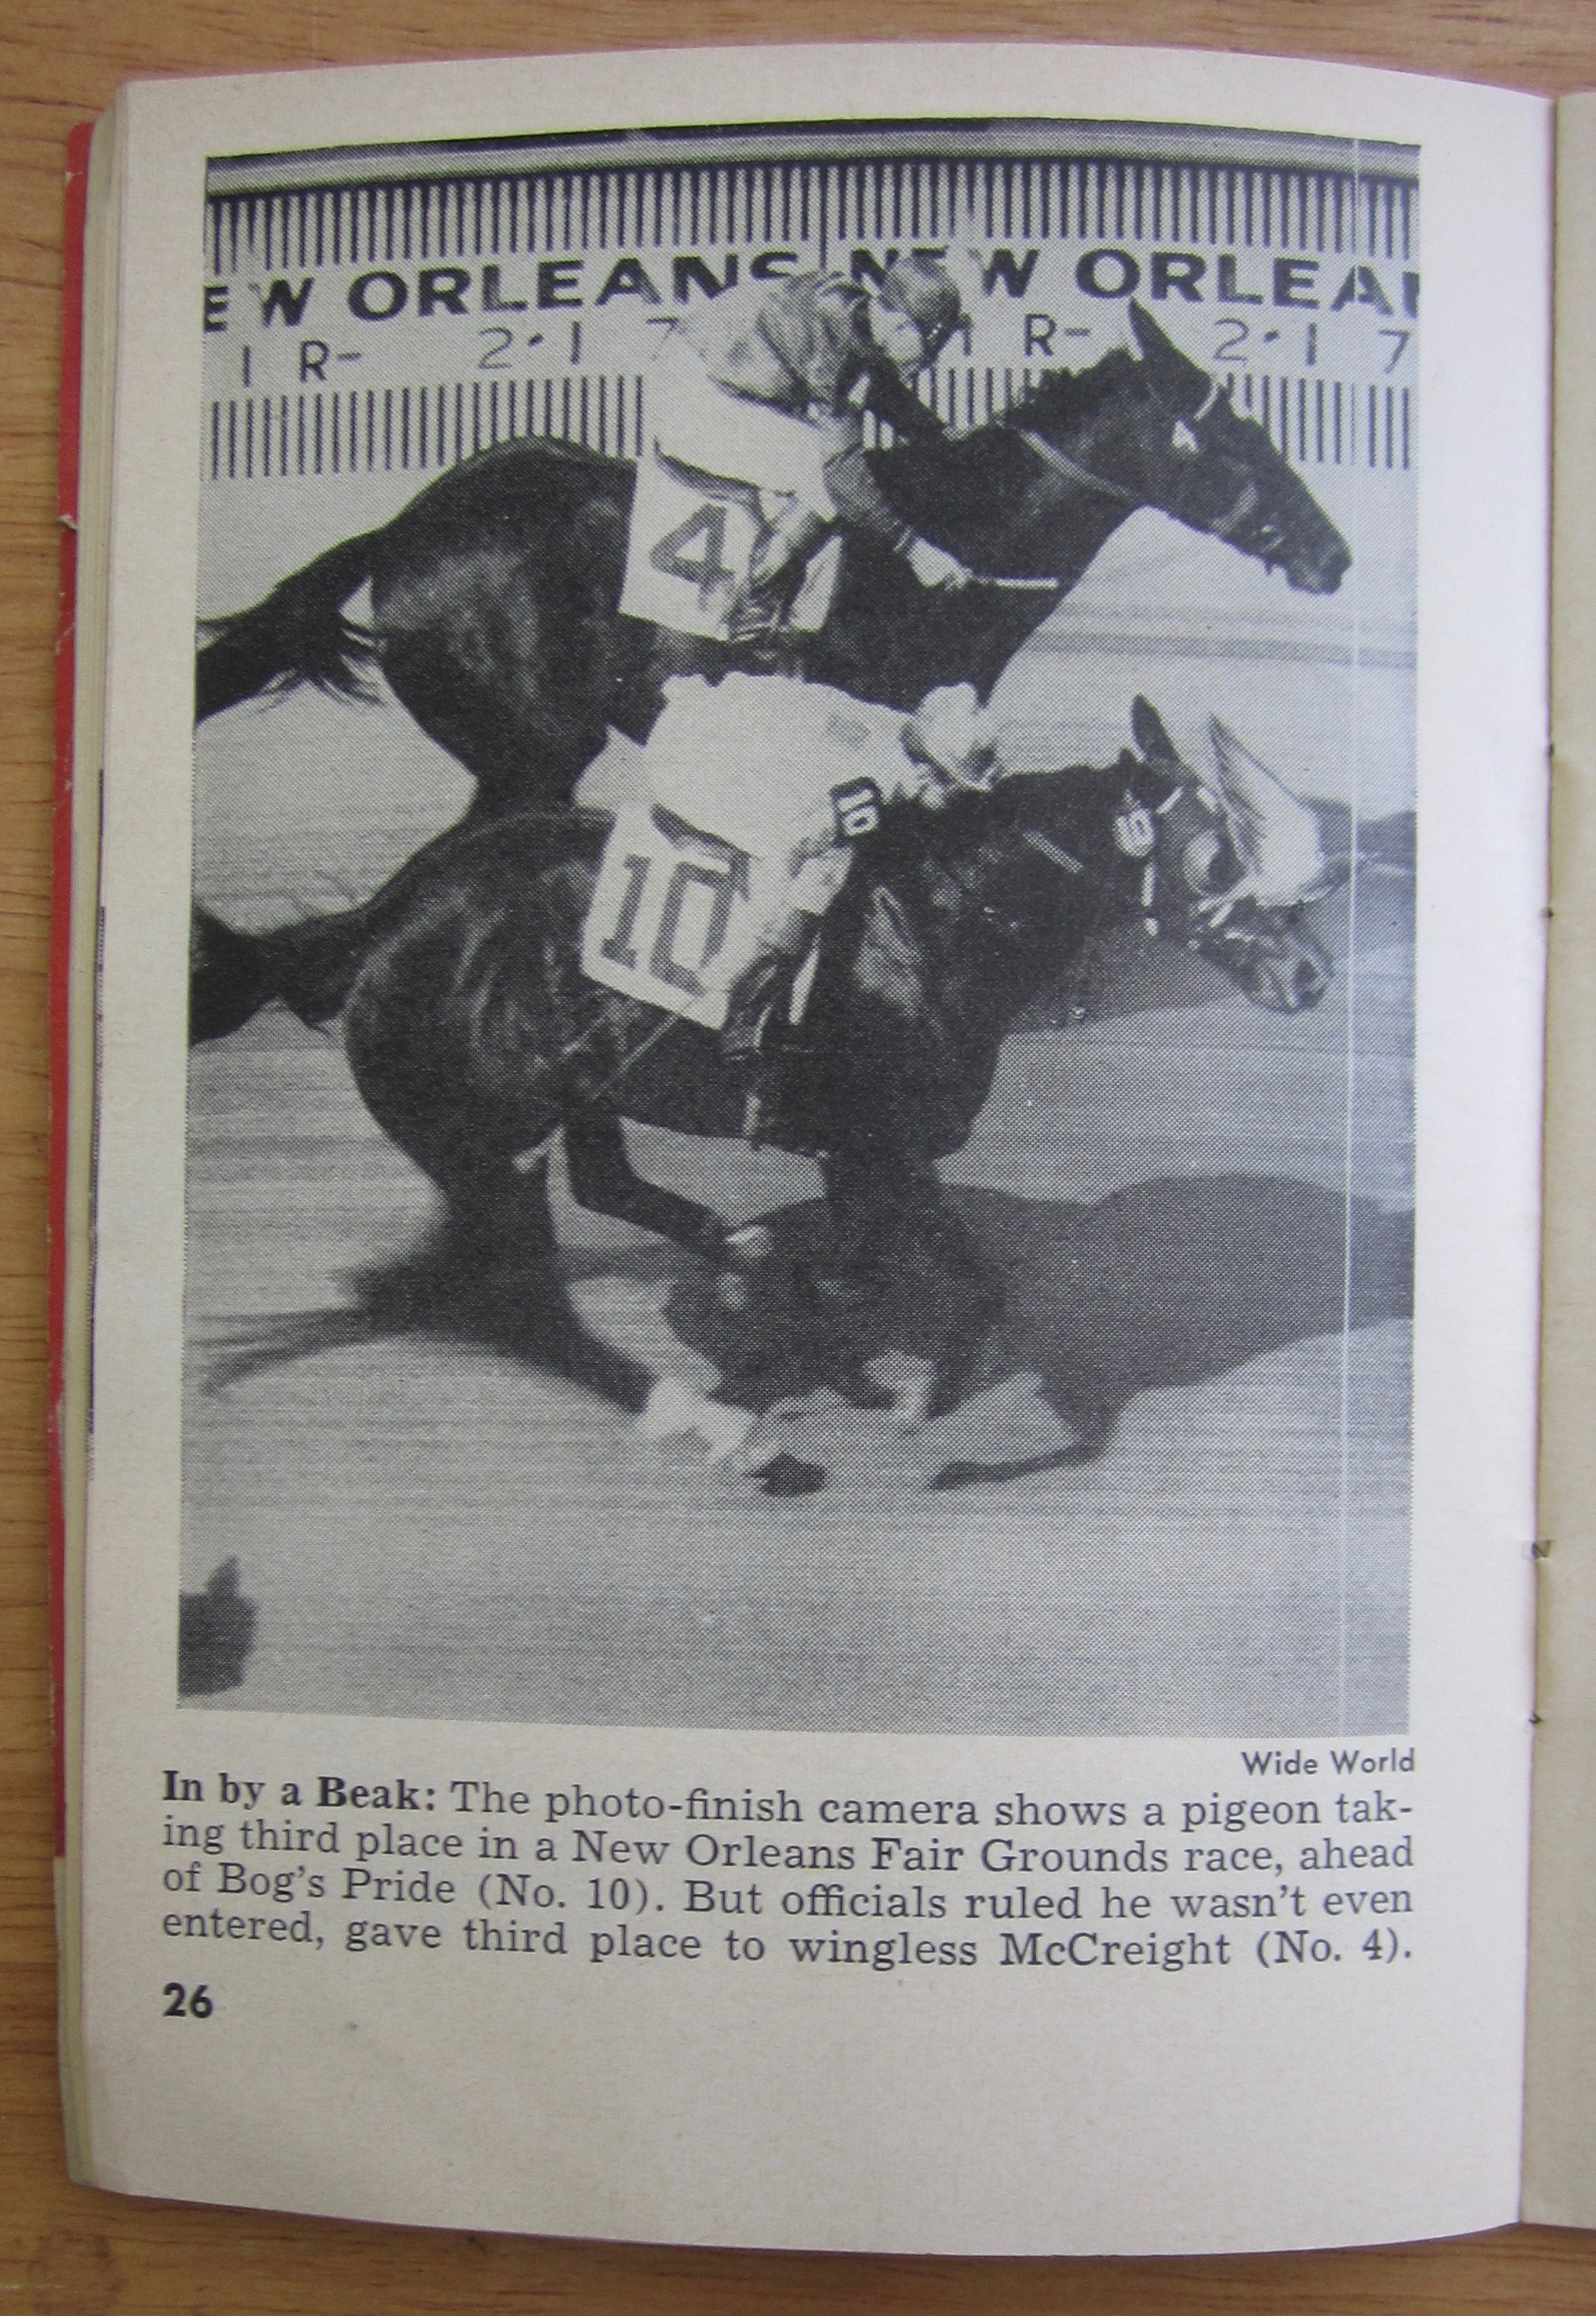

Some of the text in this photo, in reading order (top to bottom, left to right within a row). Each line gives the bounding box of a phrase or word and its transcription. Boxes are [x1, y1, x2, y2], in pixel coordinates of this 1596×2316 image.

[347, 250, 798, 321] ORLEANS
[650, 501, 736, 610] 4
[600, 850, 753, 997] 10
[1240, 1748, 1415, 1776] Wide World
[162, 1770, 1412, 1832] In by a Beak: The photo-finish camera shows a pigeon tak-
[163, 1815, 1414, 1877] ing third place in a New Orleans Fair Grounds race, ahead
[163, 1861, 202, 1892] of
[341, 1868, 455, 1903] Pride
[478, 1873, 565, 1909] (No.
[588, 1878, 664, 1915] 10).
[683, 1880, 763, 1915] But
[781, 1883, 946, 1919] officials
[965, 1886, 1083, 1919] ruled
[1101, 1886, 1151, 1919] he
[1323, 1890, 1413, 1915] even
[163, 1908, 1412, 1972] entered, gave third place to wingless McCreight (No. 4).
[163, 1983, 213, 2019] 26
